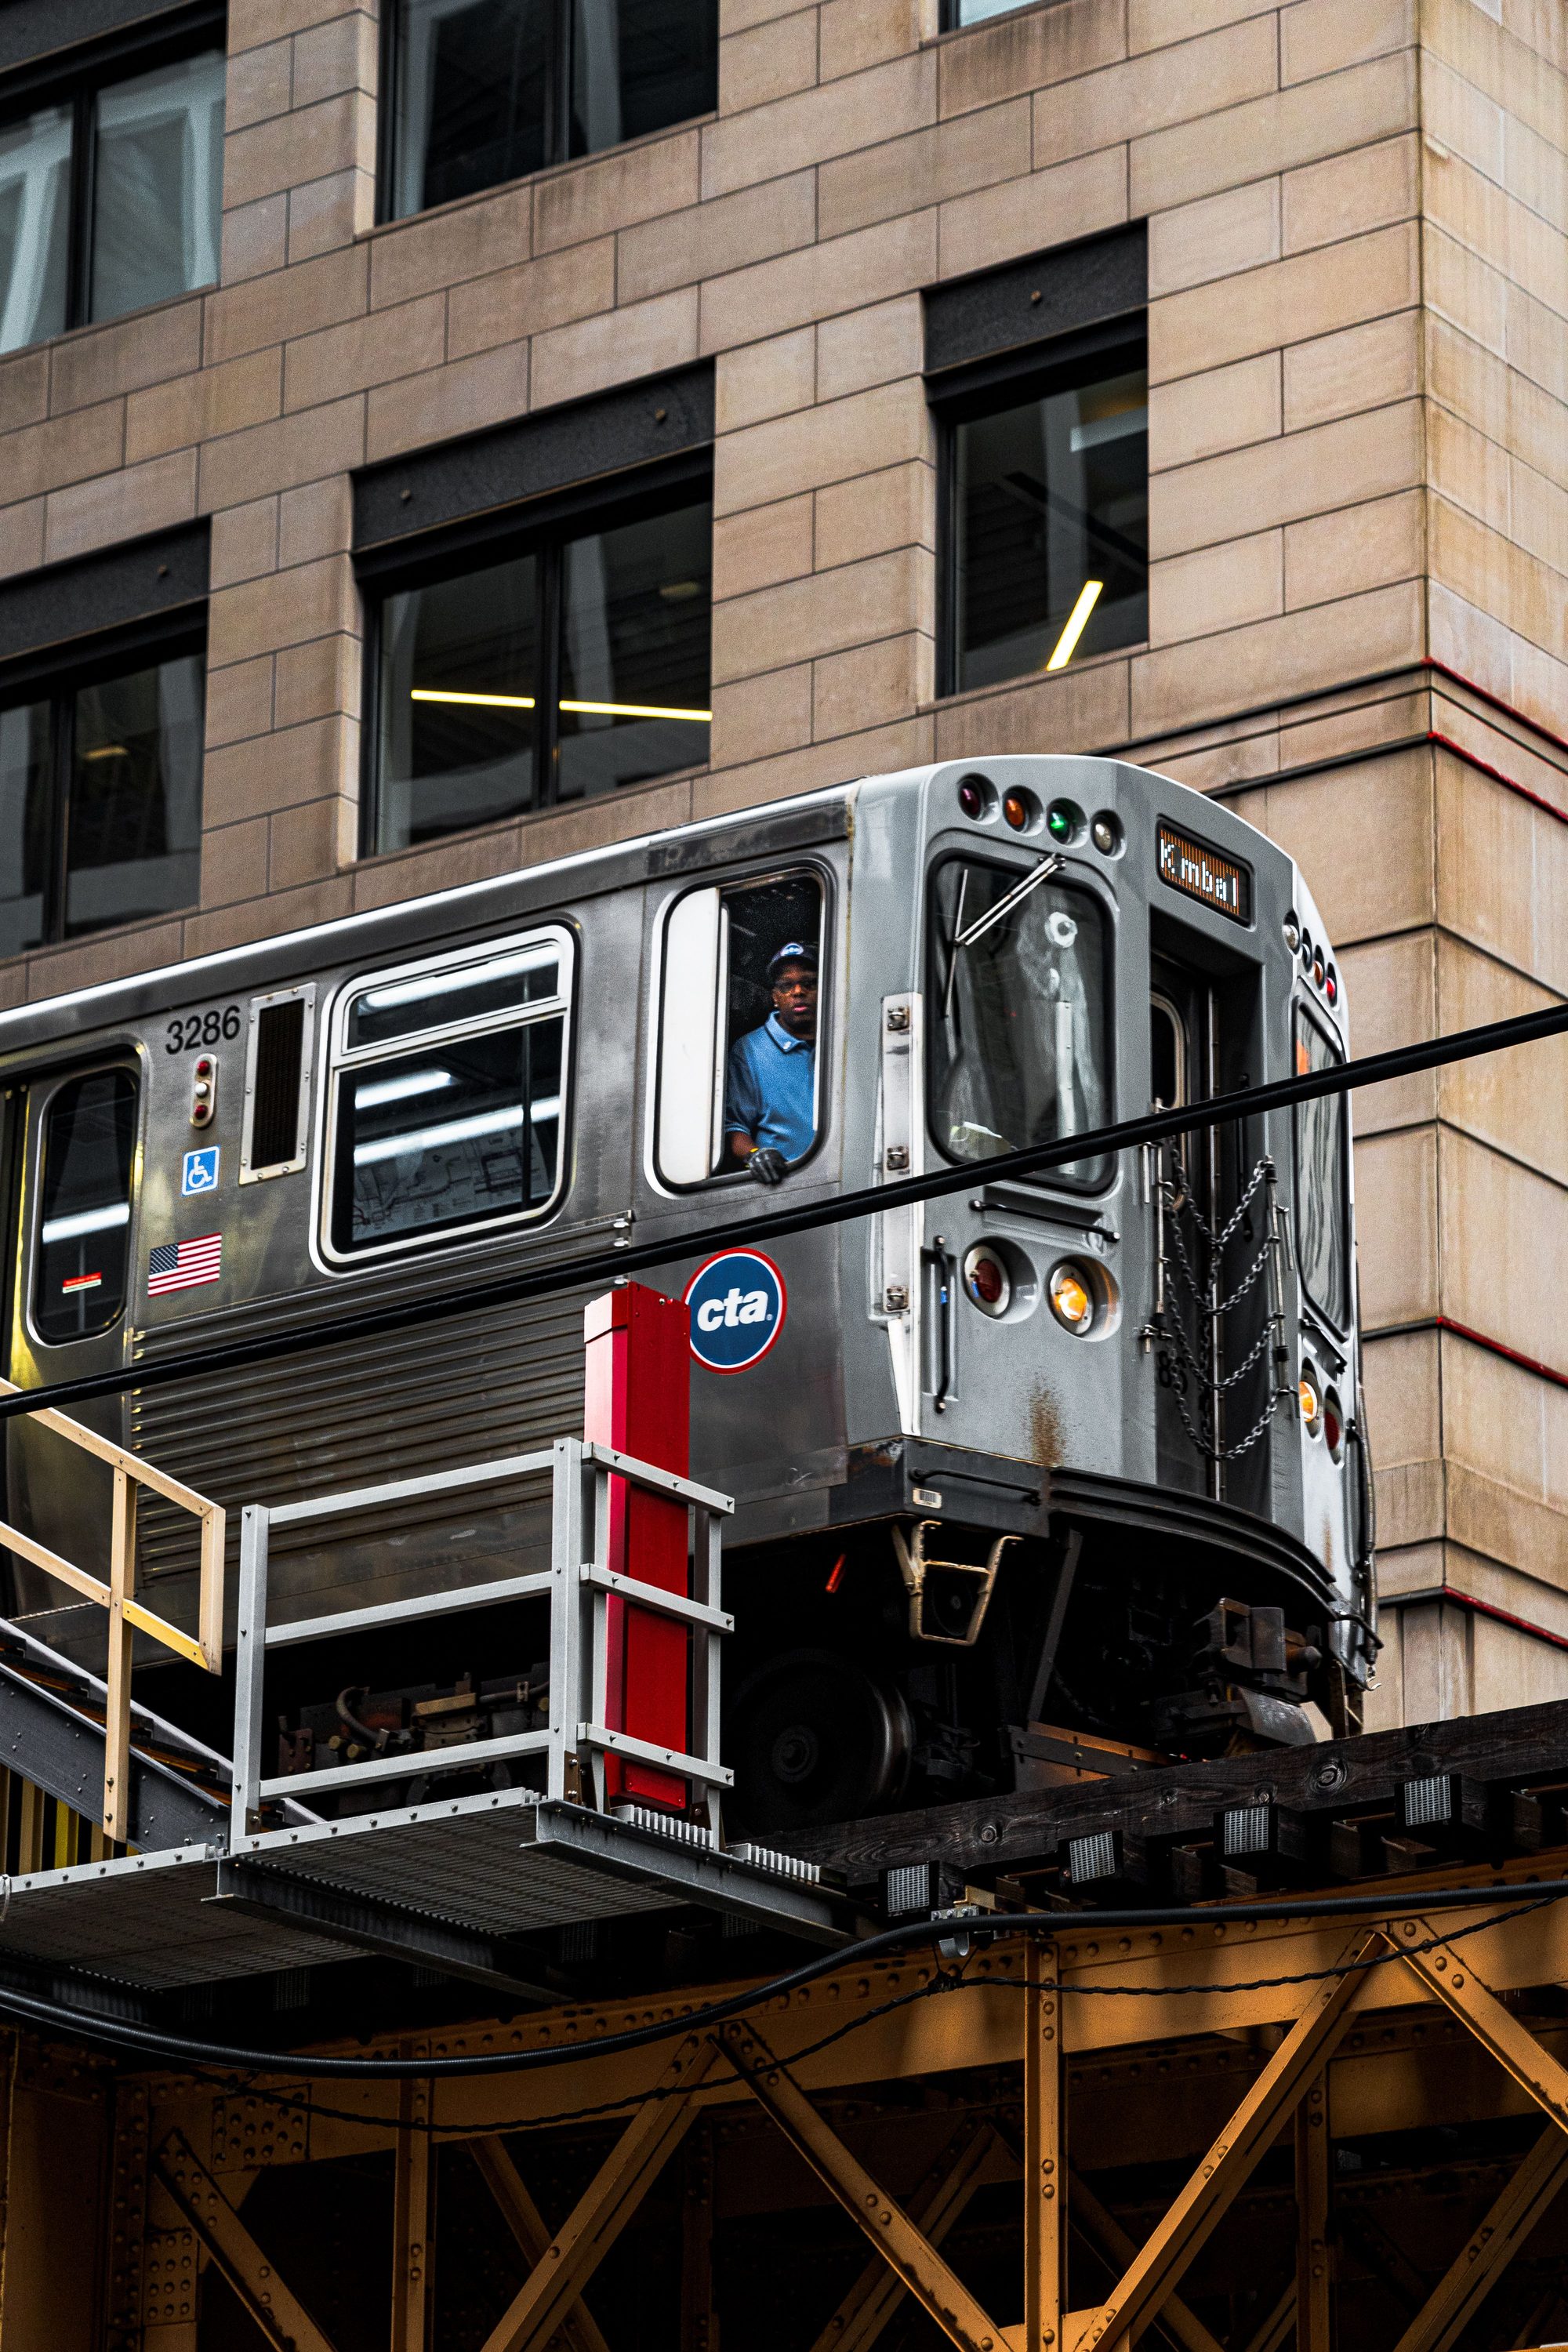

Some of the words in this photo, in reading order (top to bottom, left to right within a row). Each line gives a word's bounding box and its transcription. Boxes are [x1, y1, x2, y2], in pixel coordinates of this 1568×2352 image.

[1160, 838, 1237, 907] Kmbal
[165, 1005, 241, 1055] 3286
[697, 1288, 768, 1332] cta
